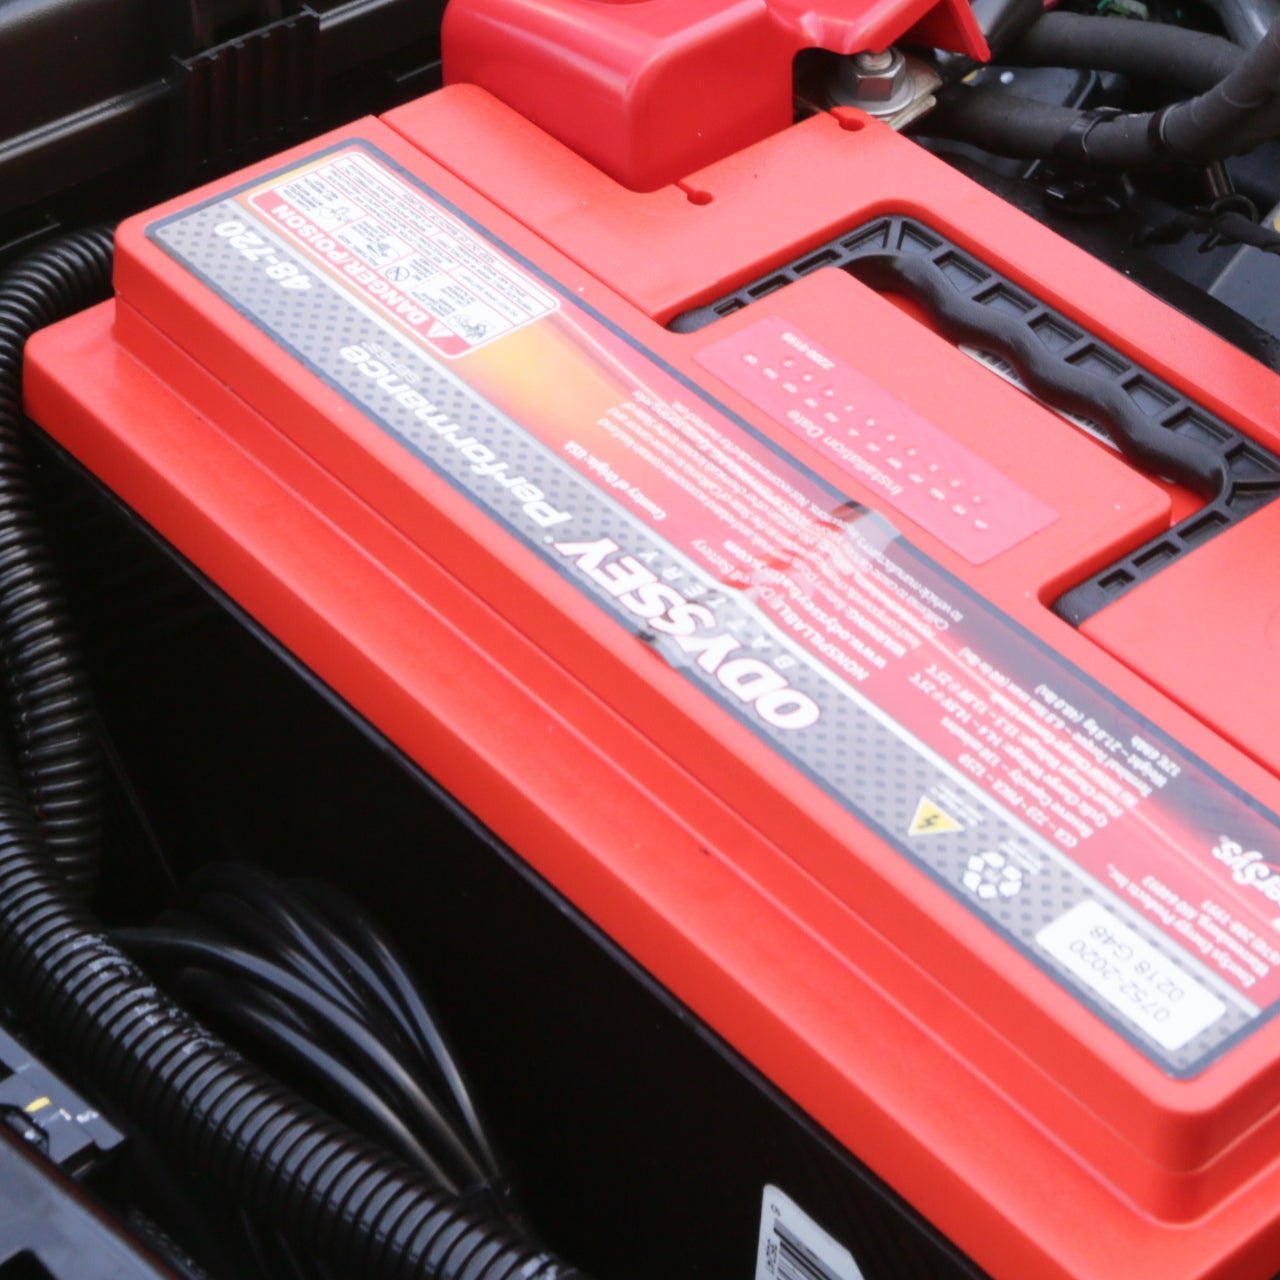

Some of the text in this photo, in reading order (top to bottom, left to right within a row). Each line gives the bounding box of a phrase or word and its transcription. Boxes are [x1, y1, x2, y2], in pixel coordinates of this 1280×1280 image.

[208, 217, 317, 295] 48-720
[268, 203, 431, 325] DANGER/POISON
[327, 341, 574, 531] Performance
[560, 439, 590, 459] USA
[781, 408, 827, 439] Date
[578, 452, 623, 484] Origin:
[817, 434, 906, 497] Installation
[620, 485, 672, 522] Country
[552, 537, 818, 732] ODYSSEY
[636, 551, 796, 669] BATTERY
[767, 596, 871, 681] NONSPILLABLE
[1003, 767, 1056, 806] Capacity
[1122, 882, 1177, 925] Products
[1169, 917, 1217, 954] Energy
[1064, 937, 1173, 1023] 0752-2020
[1085, 923, 1188, 1003] 0218 G48
